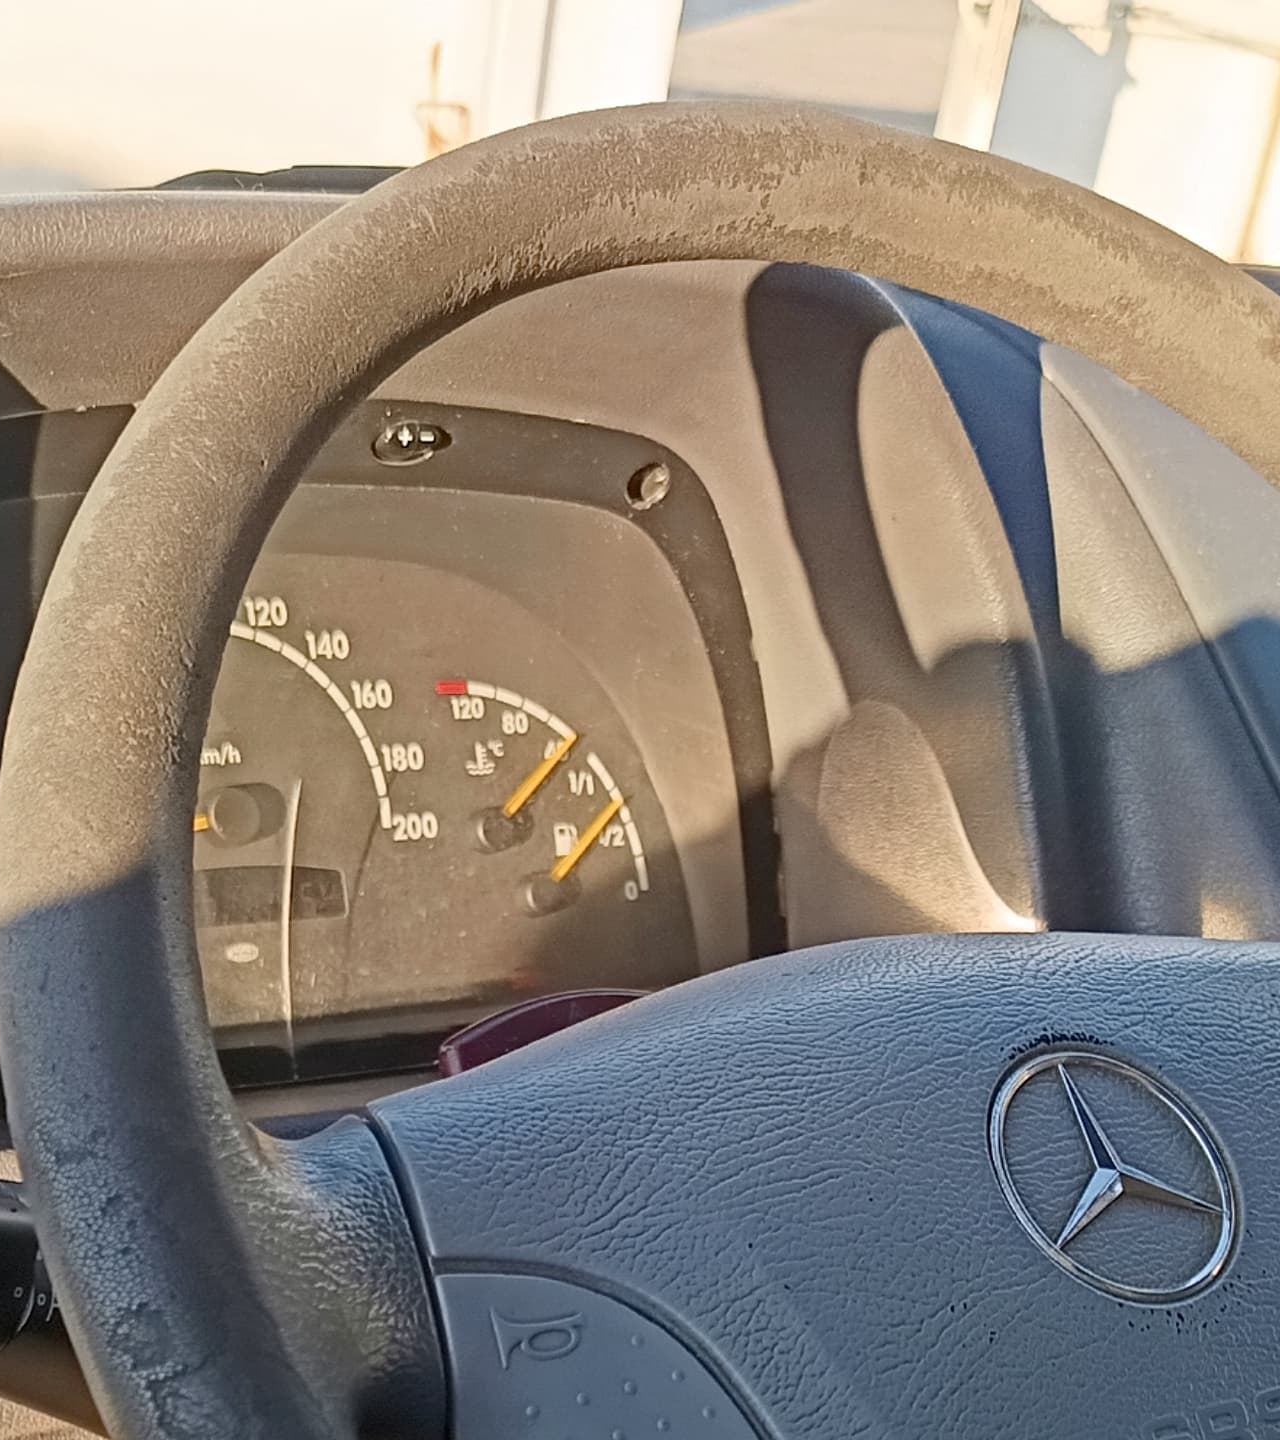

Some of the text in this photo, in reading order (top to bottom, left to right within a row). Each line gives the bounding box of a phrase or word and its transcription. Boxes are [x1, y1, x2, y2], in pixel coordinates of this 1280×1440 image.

[245, 597, 287, 627] 120
[306, 630, 349, 660] 140
[351, 680, 393, 710] 160
[451, 697, 484, 720] 120
[502, 711, 529, 734] 80
[382, 742, 424, 771] 180
[392, 812, 438, 840] 200
